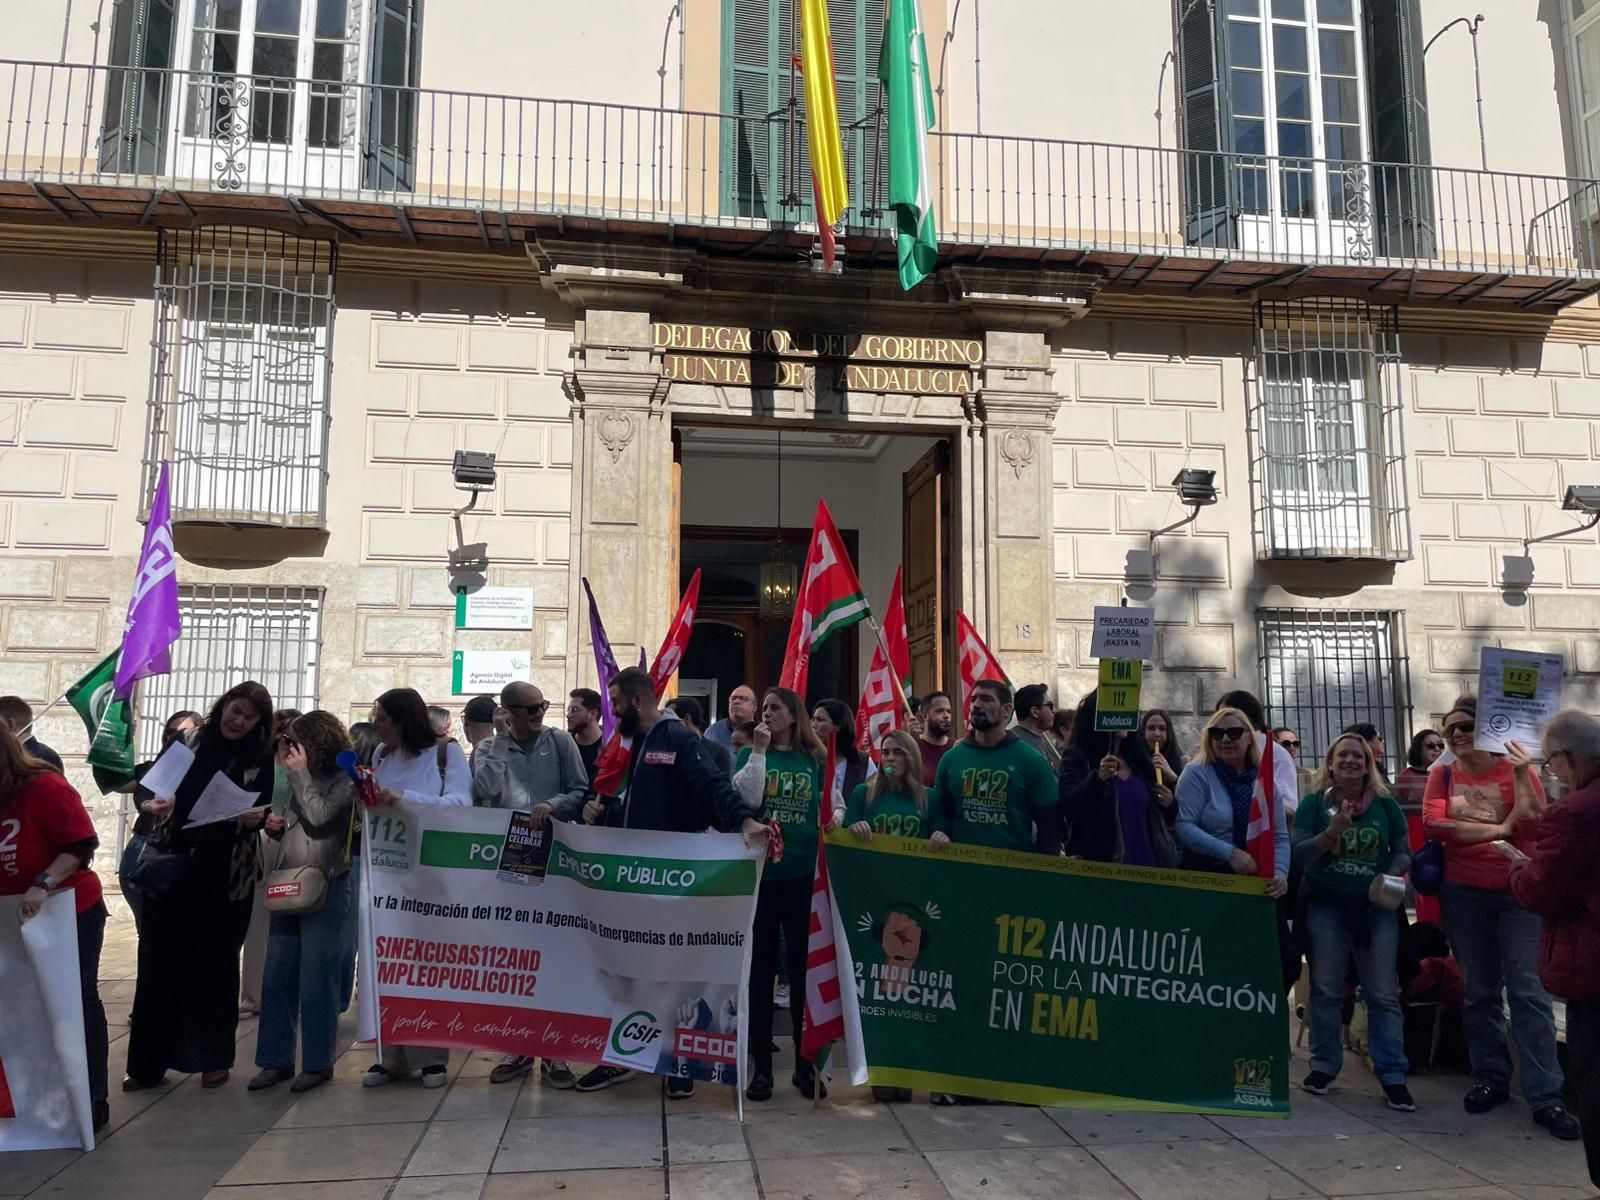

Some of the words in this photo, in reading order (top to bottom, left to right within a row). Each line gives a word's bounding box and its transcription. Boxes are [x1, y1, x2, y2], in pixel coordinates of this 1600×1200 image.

[653, 323, 801, 353] DELEGACION
[811, 332, 856, 357] DEL
[865, 335, 983, 363] GOBIERNO
[664, 356, 751, 383] JUNTA
[775, 361, 804, 386] DE
[838, 364, 971, 394] ANDALUCIA
[1016, 623, 1033, 639] 18
[1099, 617, 1150, 625] PRECARIEDAD
[1107, 628, 1140, 637] LABORAL
[1111, 661, 1131, 680] EMA
[1509, 671, 1532, 682] 112
[1113, 690, 1127, 707] 112
[766, 768, 812, 801] 112
[961, 767, 1009, 801] 112
[370, 815, 406, 844] 112
[873, 813, 921, 837] 112
[963, 809, 1009, 825] ASEMA
[508, 834, 543, 848] CELEBRAR
[510, 825, 529, 836] NADA
[530, 830, 545, 839] QUE
[616, 861, 696, 887] PÚBLICO
[900, 842, 918, 851] 112
[984, 852, 1002, 861] TUS
[1114, 868, 1158, 880] ATIENDE
[1159, 872, 1177, 882] LAS
[385, 895, 397, 909] la
[400, 896, 469, 919] integración
[471, 904, 491, 920] del
[494, 906, 512, 922] 112
[514, 909, 530, 922] en
[532, 909, 544, 924] la
[545, 910, 589, 930] Agencia
[598, 923, 666, 945] Emergencias
[669, 932, 684, 946] de
[686, 930, 745, 947] Andalucía
[995, 913, 1046, 958] 112
[1049, 920, 1204, 977] ANDALUCÍA
[376, 961, 537, 997] MPLEOPUBLICO112
[870, 963, 953, 990] ANDALUCÍA
[993, 960, 1044, 988] POR
[1053, 967, 1083, 992] LA
[1090, 970, 1277, 1015] INTEGRACIÓN
[873, 980, 957, 1011] LUCHA
[861, 1005, 886, 1016] ROES
[887, 1007, 937, 1023] INVISIBLES
[989, 987, 1023, 1032] EN
[1030, 991, 1099, 1041] EMA
[391, 1007, 439, 1034] poder
[446, 1012, 465, 1036] de
[473, 1015, 535, 1039] cambiar
[541, 1022, 564, 1045] las
[571, 1032, 608, 1050] cosas
[622, 1022, 664, 1044] CSIF
[678, 1033, 737, 1059] CCOO
[1232, 1057, 1272, 1089] 112
[1233, 1093, 1274, 1107] ASEMA
